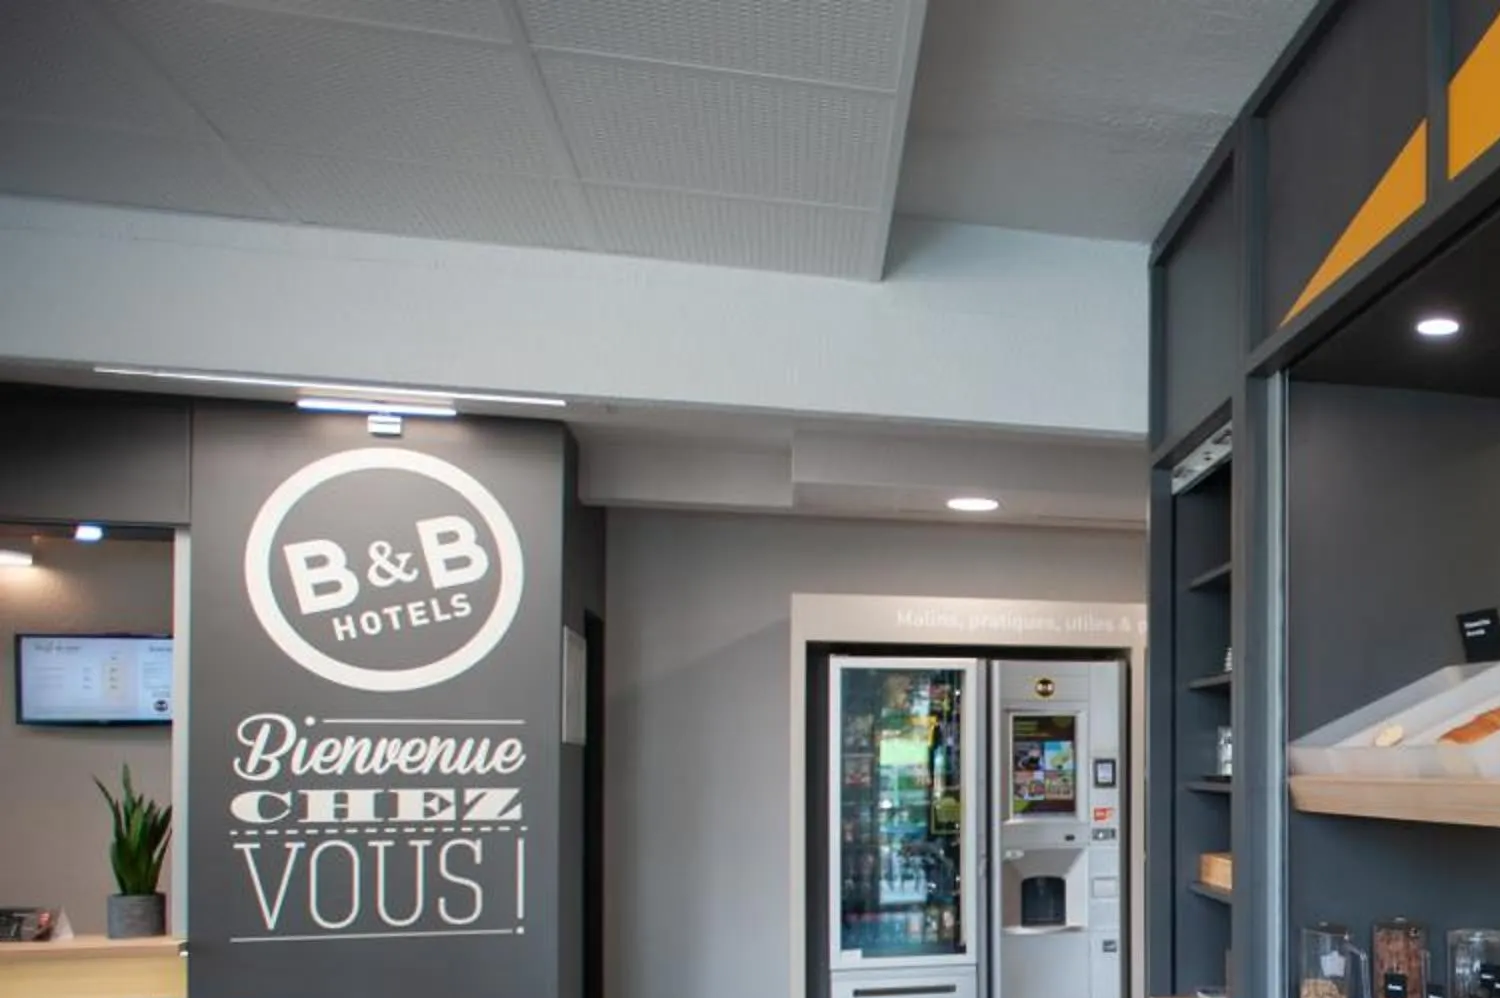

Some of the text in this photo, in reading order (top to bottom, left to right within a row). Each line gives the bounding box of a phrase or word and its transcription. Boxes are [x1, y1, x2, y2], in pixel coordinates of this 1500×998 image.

[332, 592, 473, 642] HOTELS
[233, 713, 527, 782] Bienvenue
[230, 788, 523, 824] CHEZ
